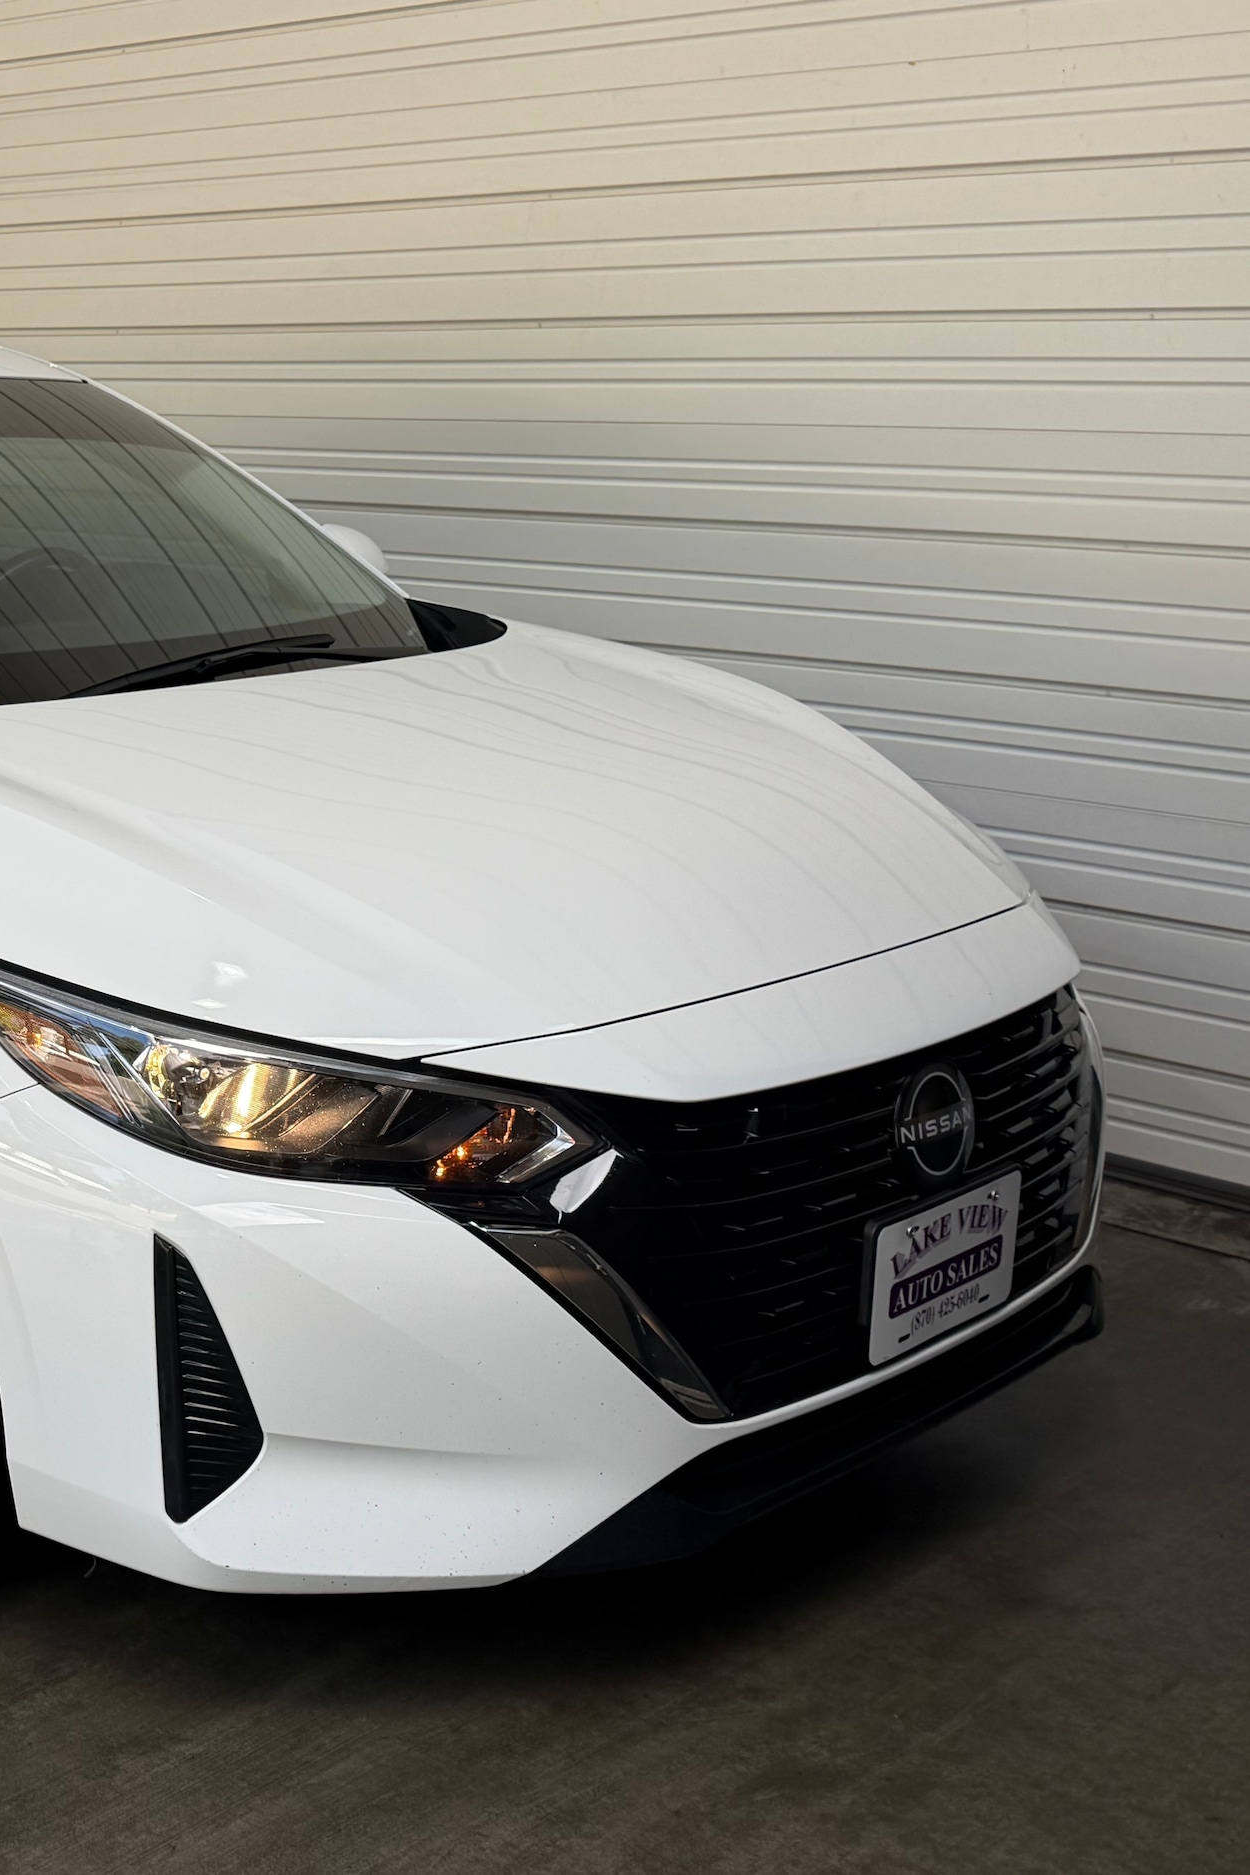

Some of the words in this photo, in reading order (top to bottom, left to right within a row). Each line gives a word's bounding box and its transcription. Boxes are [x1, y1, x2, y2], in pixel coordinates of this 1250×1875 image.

[900, 1106, 971, 1144] NISSAN
[891, 1213, 952, 1279] LAKE
[958, 1204, 1008, 1236] VIEW
[893, 1269, 944, 1313] AUTO
[946, 1242, 999, 1287] SALES
[911, 1305, 936, 1336] (870)
